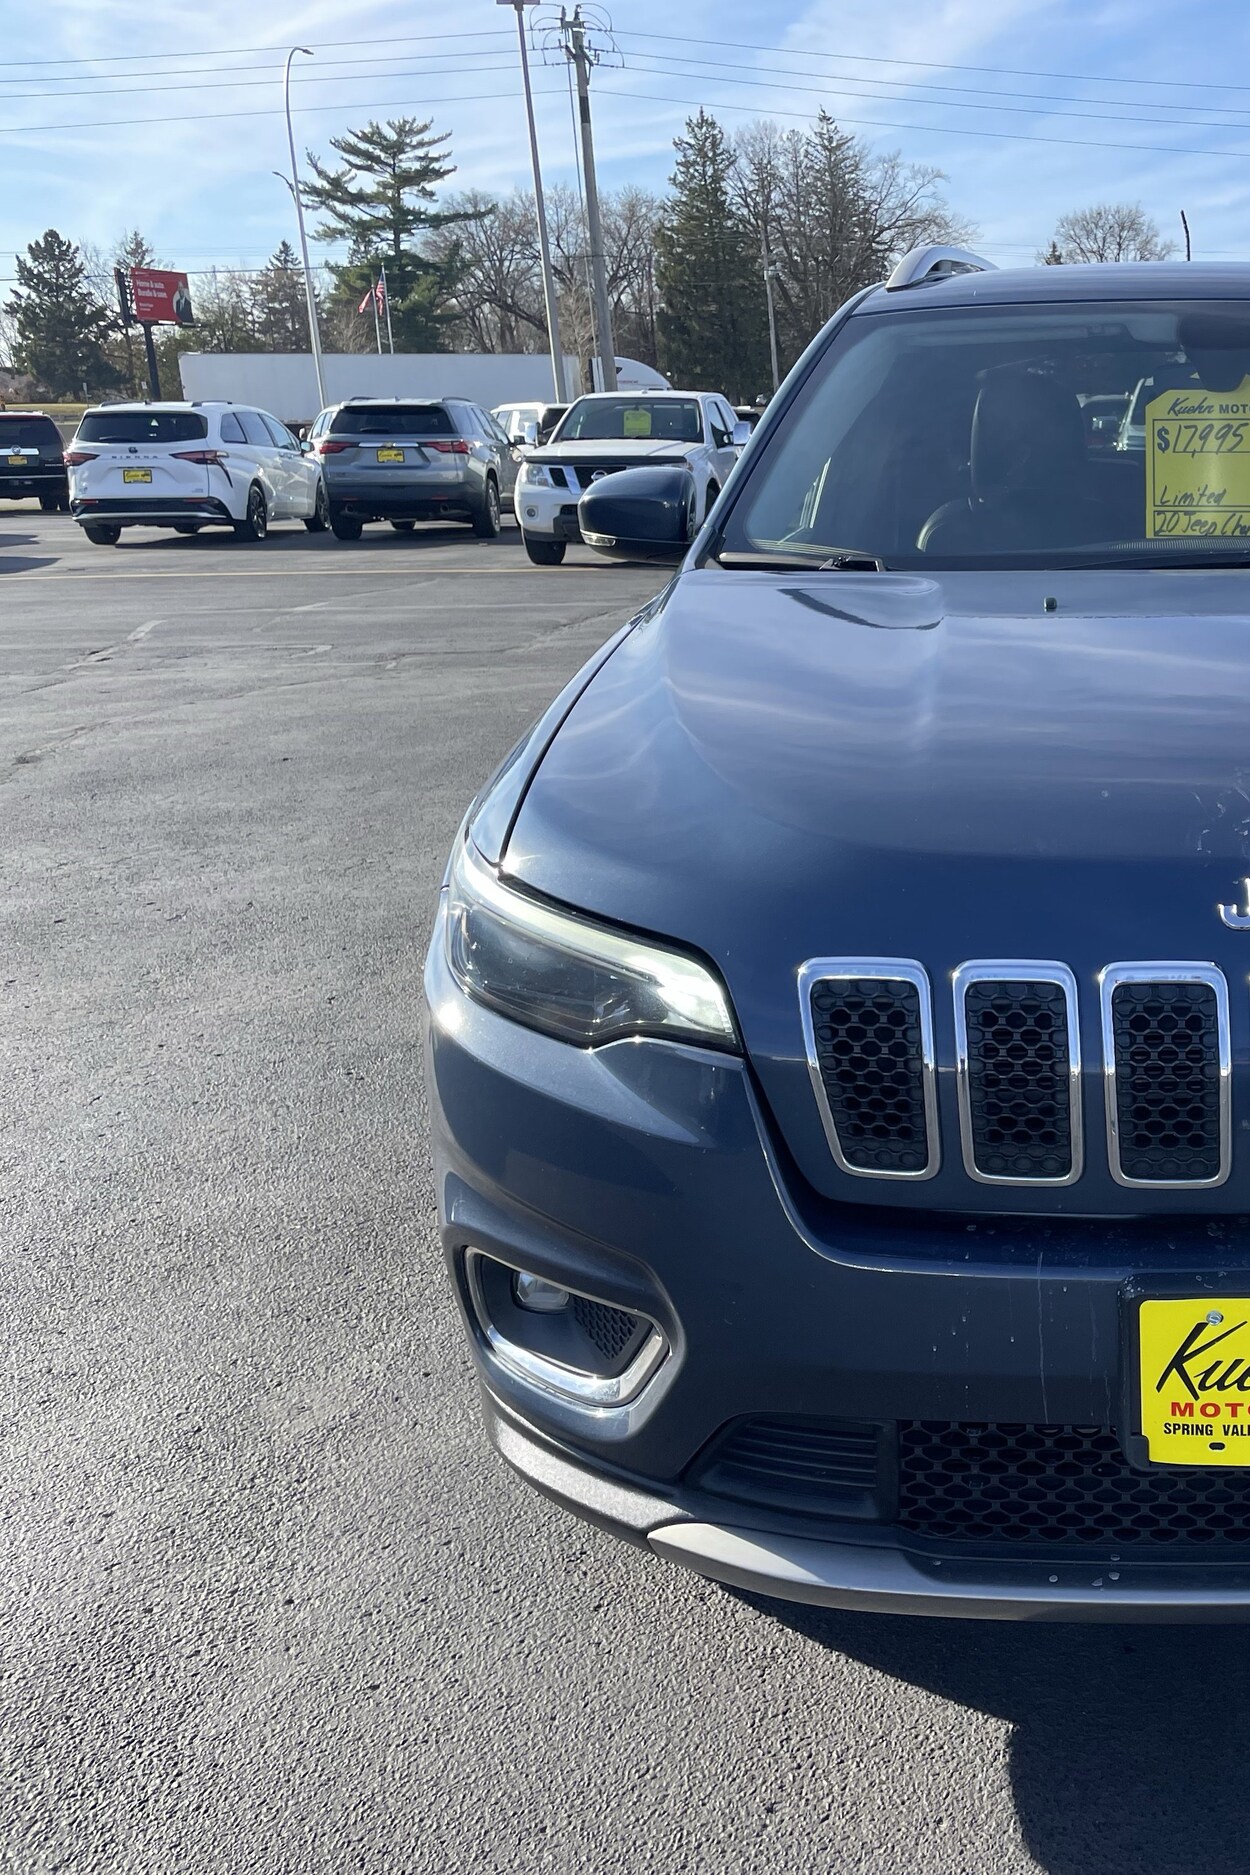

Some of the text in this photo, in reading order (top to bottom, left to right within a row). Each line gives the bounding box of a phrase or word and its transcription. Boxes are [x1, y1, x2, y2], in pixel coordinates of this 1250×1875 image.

[1168, 397, 1214, 416] Kuehn
[1159, 484, 1227, 506] Limited
[1155, 512, 1180, 535] 20
[1180, 512, 1216, 537] Jeep
[1163, 1422, 1213, 1436] SPRING
